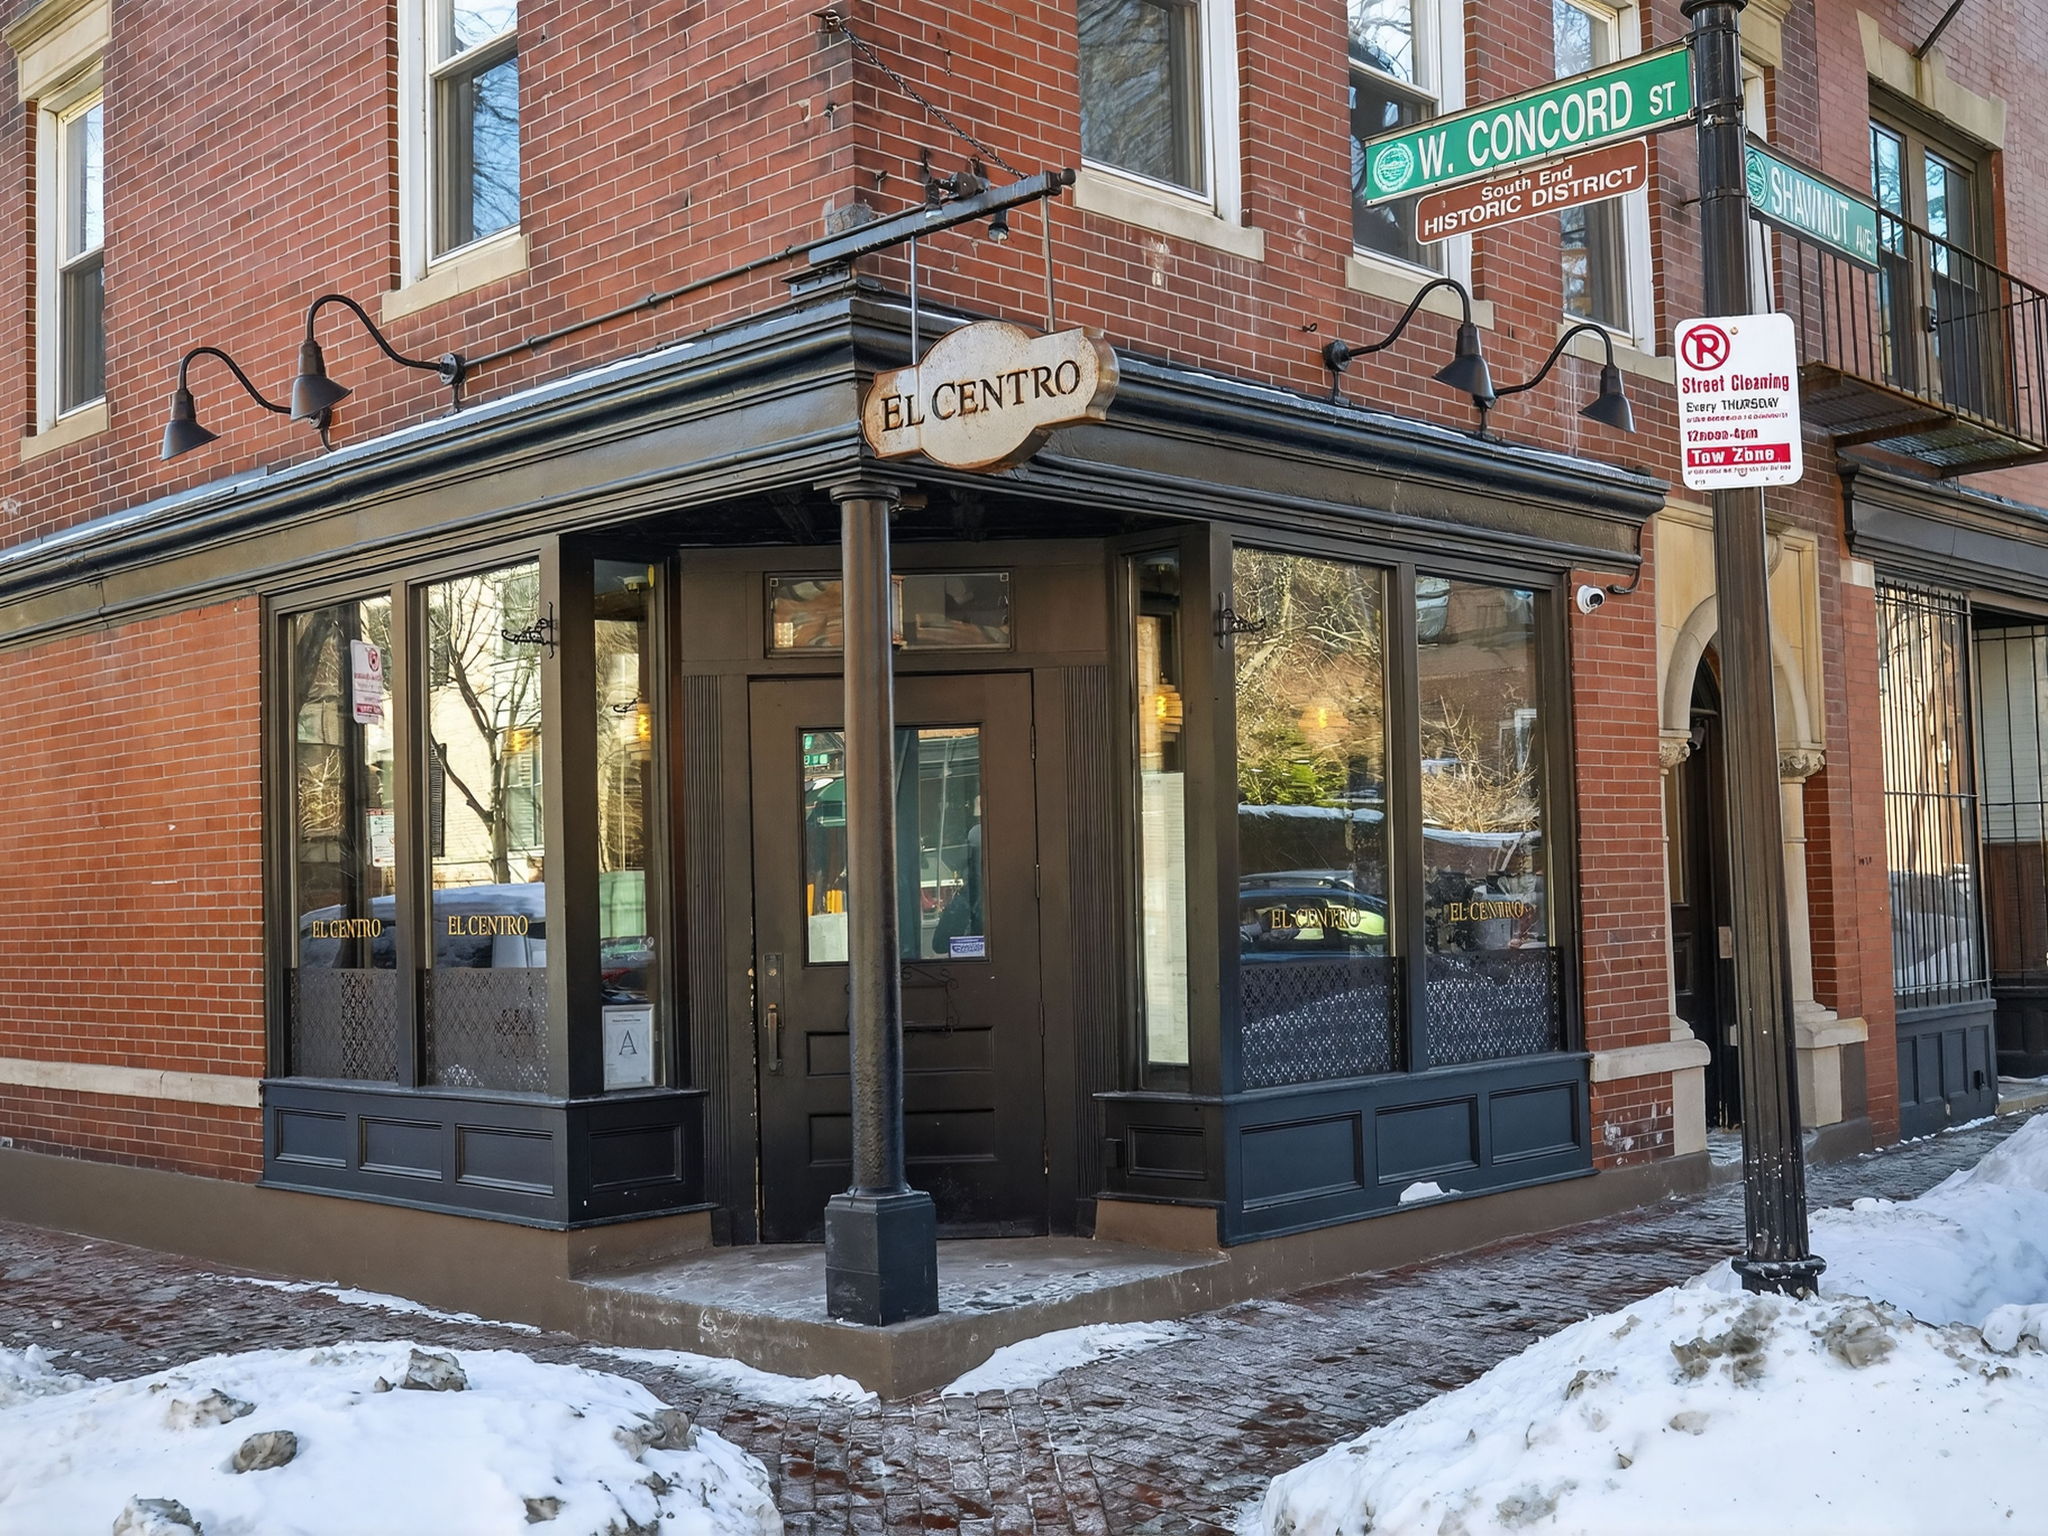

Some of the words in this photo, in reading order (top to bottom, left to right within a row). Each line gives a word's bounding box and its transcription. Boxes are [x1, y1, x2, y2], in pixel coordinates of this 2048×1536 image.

[1417, 131, 1455, 180] W.
[1467, 80, 1634, 168] CONCORD
[1649, 81, 1677, 116] ST
[1481, 177, 1531, 201] South
[1538, 164, 1574, 187] End
[1424, 195, 1523, 237] HISTORIC
[1531, 165, 1638, 208] DISTRICT
[1771, 166, 1849, 245] SHAWMUT
[1682, 375, 1725, 394] Street
[1731, 373, 1790, 392] Cleaning
[881, 393, 926, 433] EL
[931, 359, 1081, 420] CENTRO
[1686, 402, 1717, 414] Every
[1721, 398, 1779, 411] THURSDAY
[1691, 450, 1725, 465] Tow
[1732, 447, 1775, 462] Zone
[1271, 909, 1293, 929] EL
[1295, 907, 1361, 929] CENTRO
[1450, 903, 1467, 922] EL
[1470, 900, 1525, 921] CENTRO
[312, 920, 328, 938] EL
[330, 919, 381, 938] CENTRO
[448, 916, 466, 935] EL
[468, 915, 529, 936] CENTRO
[618, 1029, 638, 1056] A
